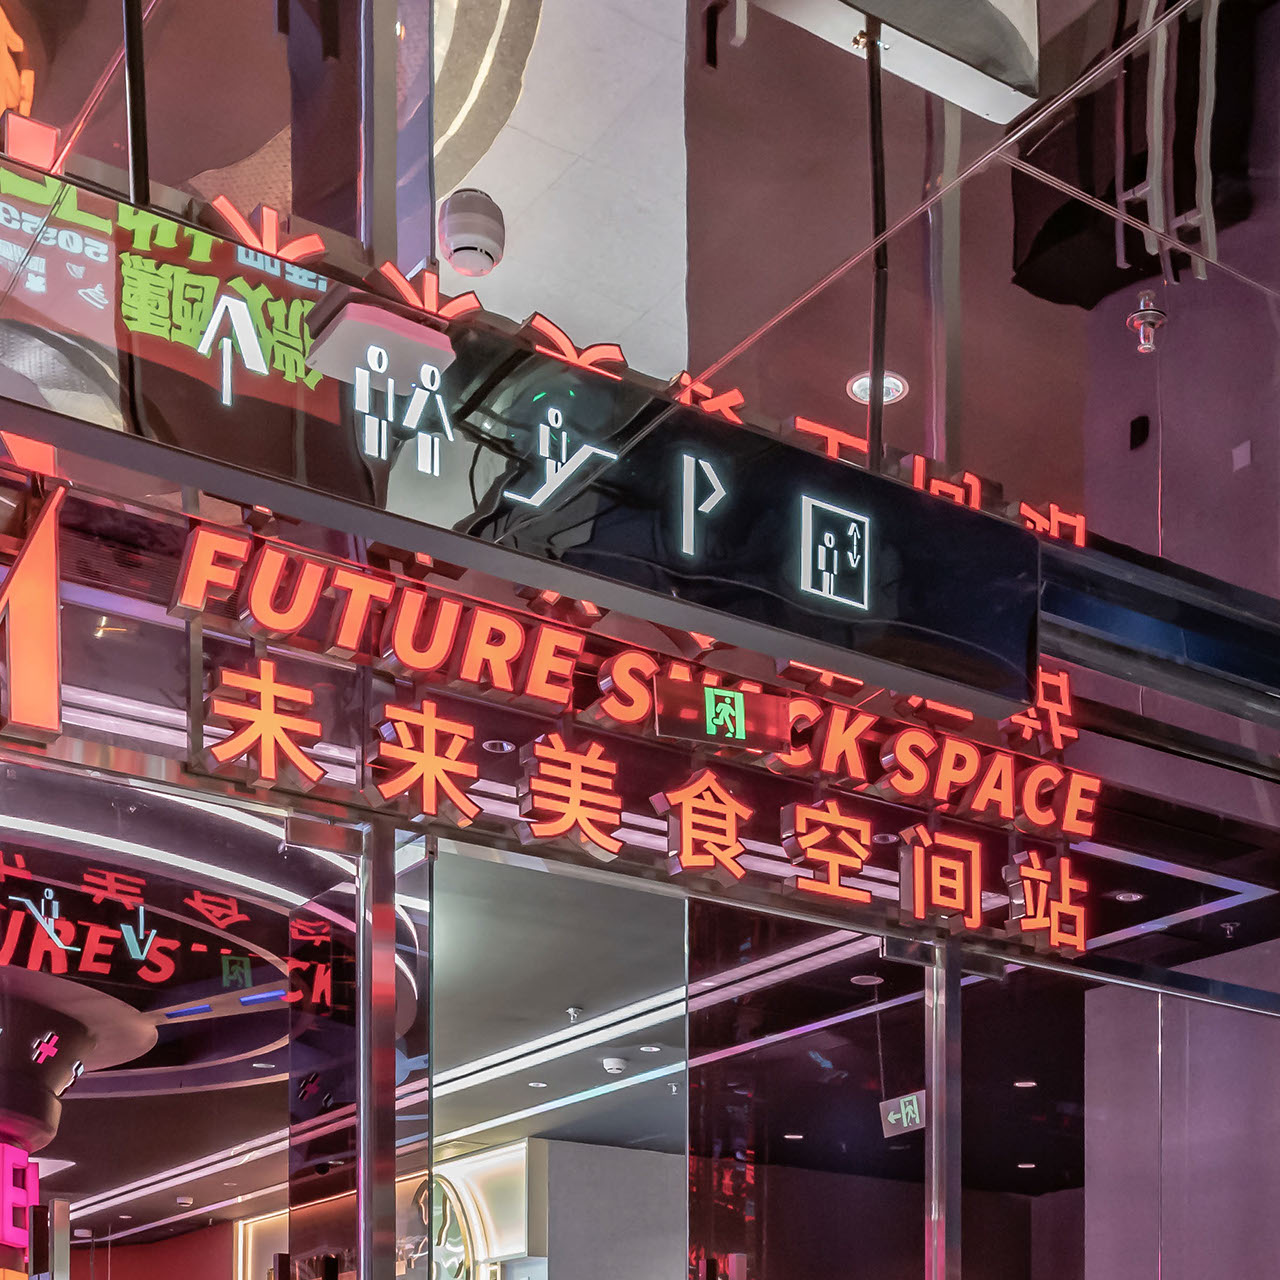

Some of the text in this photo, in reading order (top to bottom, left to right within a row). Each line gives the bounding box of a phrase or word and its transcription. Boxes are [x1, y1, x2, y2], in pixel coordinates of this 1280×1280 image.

[172, 526, 1102, 838] FUTURE SCK SPACE
[208, 658, 1088, 953] 未来美食空间站
